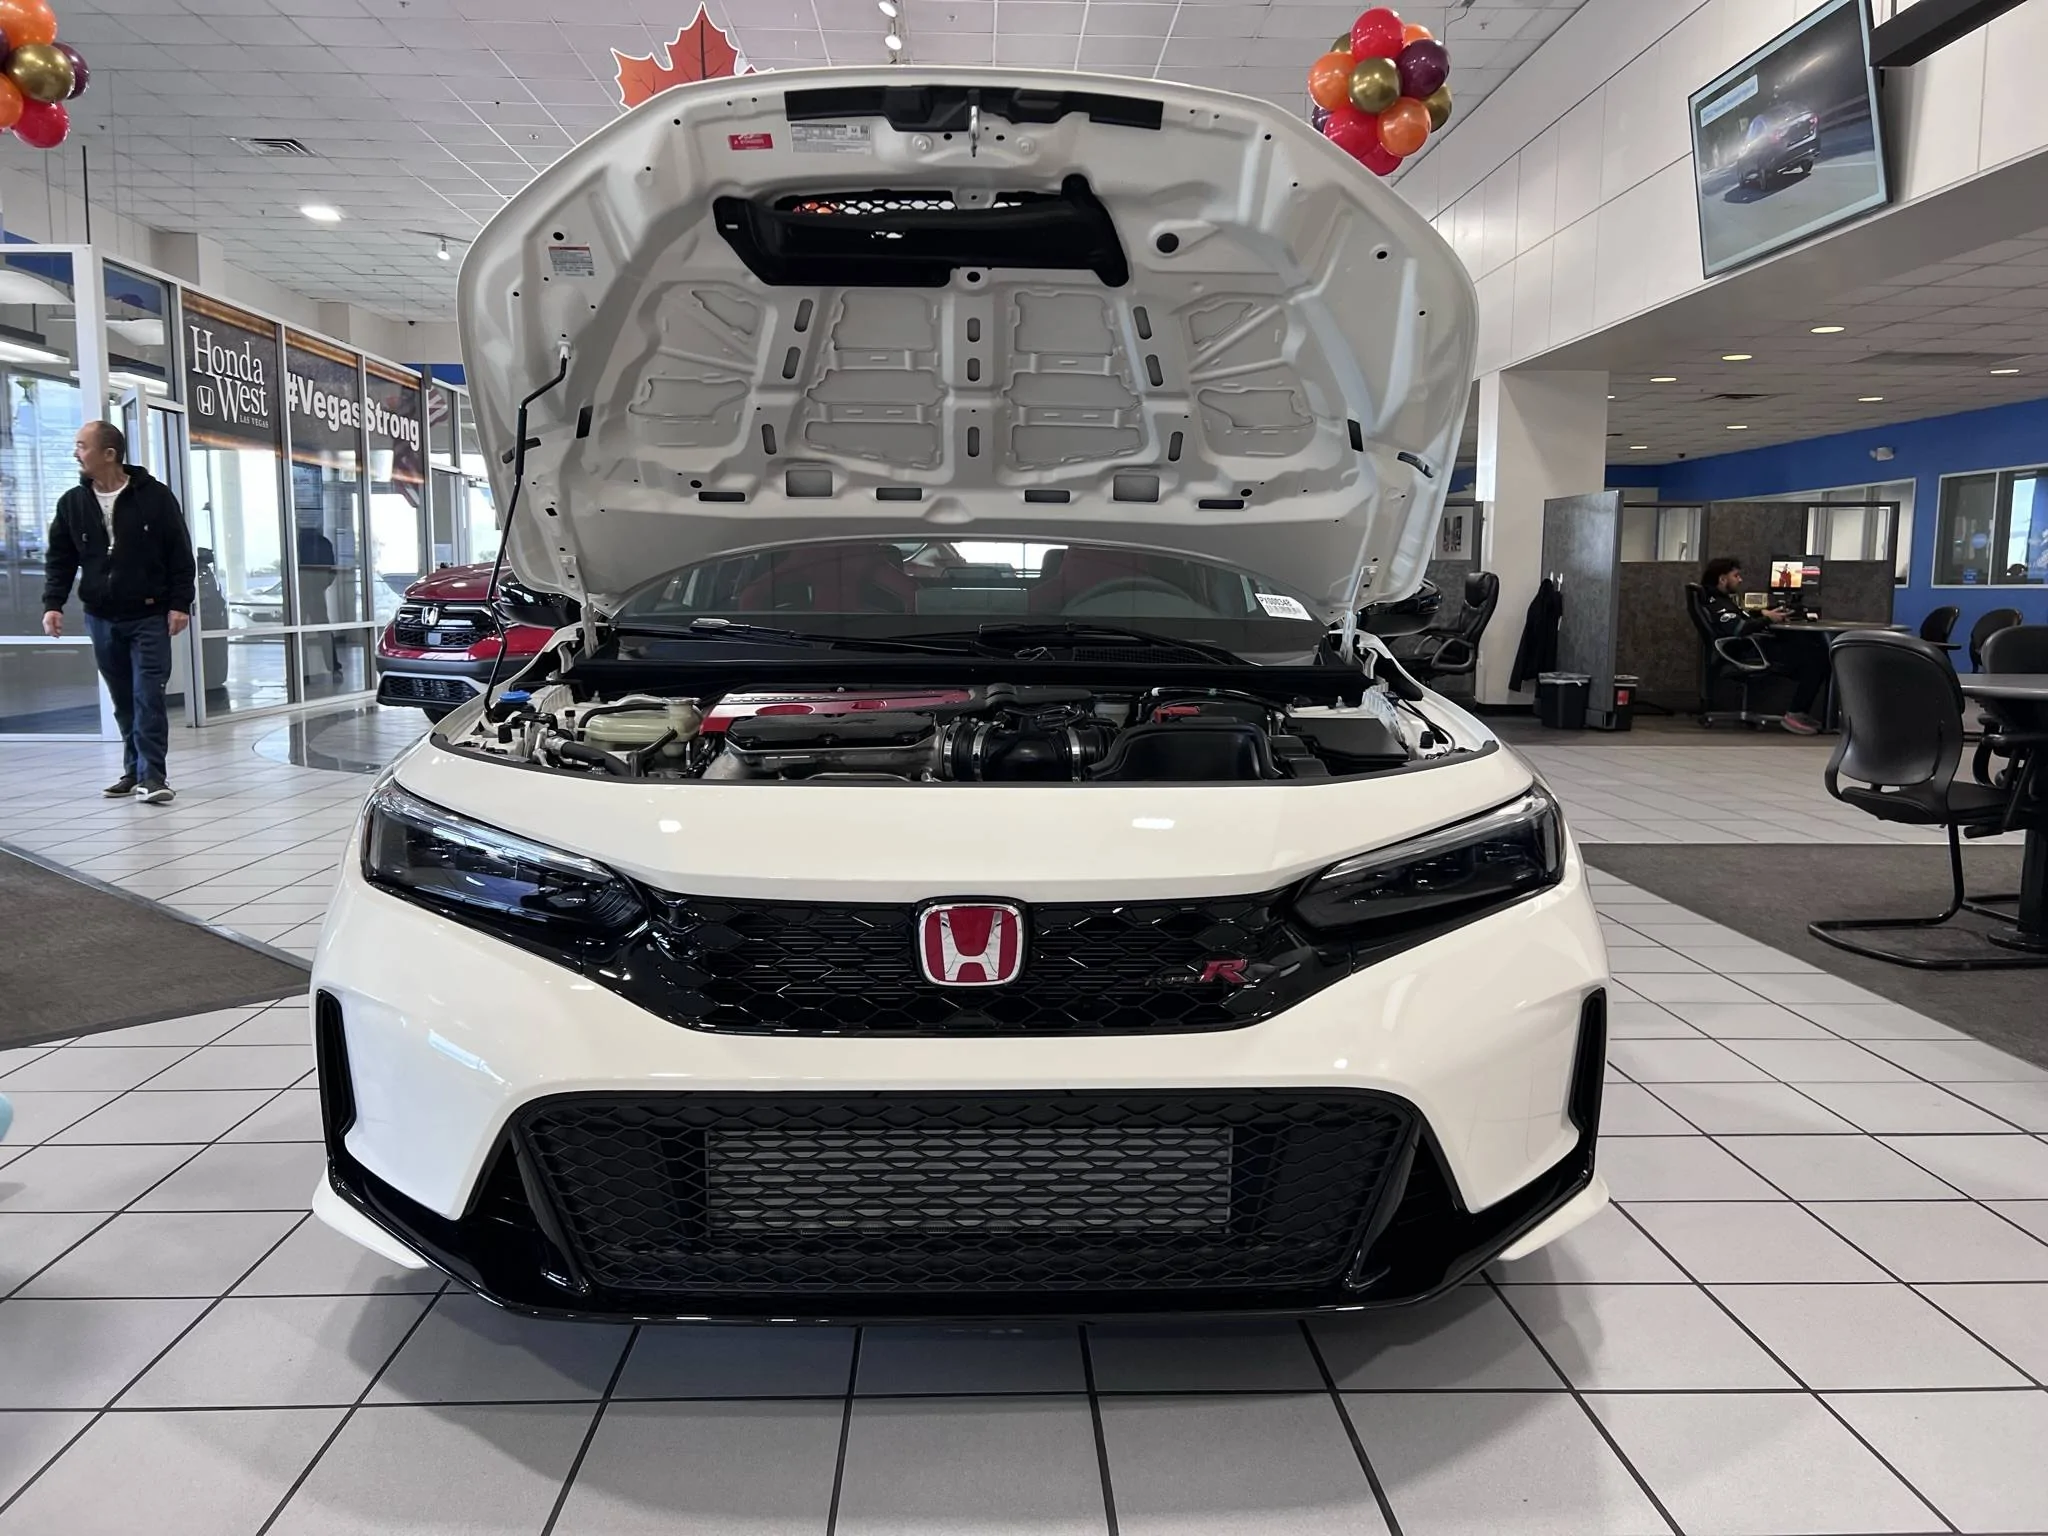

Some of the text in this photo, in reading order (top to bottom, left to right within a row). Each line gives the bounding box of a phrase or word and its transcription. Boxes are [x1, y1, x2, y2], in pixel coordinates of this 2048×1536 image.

[190, 325, 265, 385] Honda
[215, 376, 268, 423] West
[240, 414, 269, 428] LAS VEGAS
